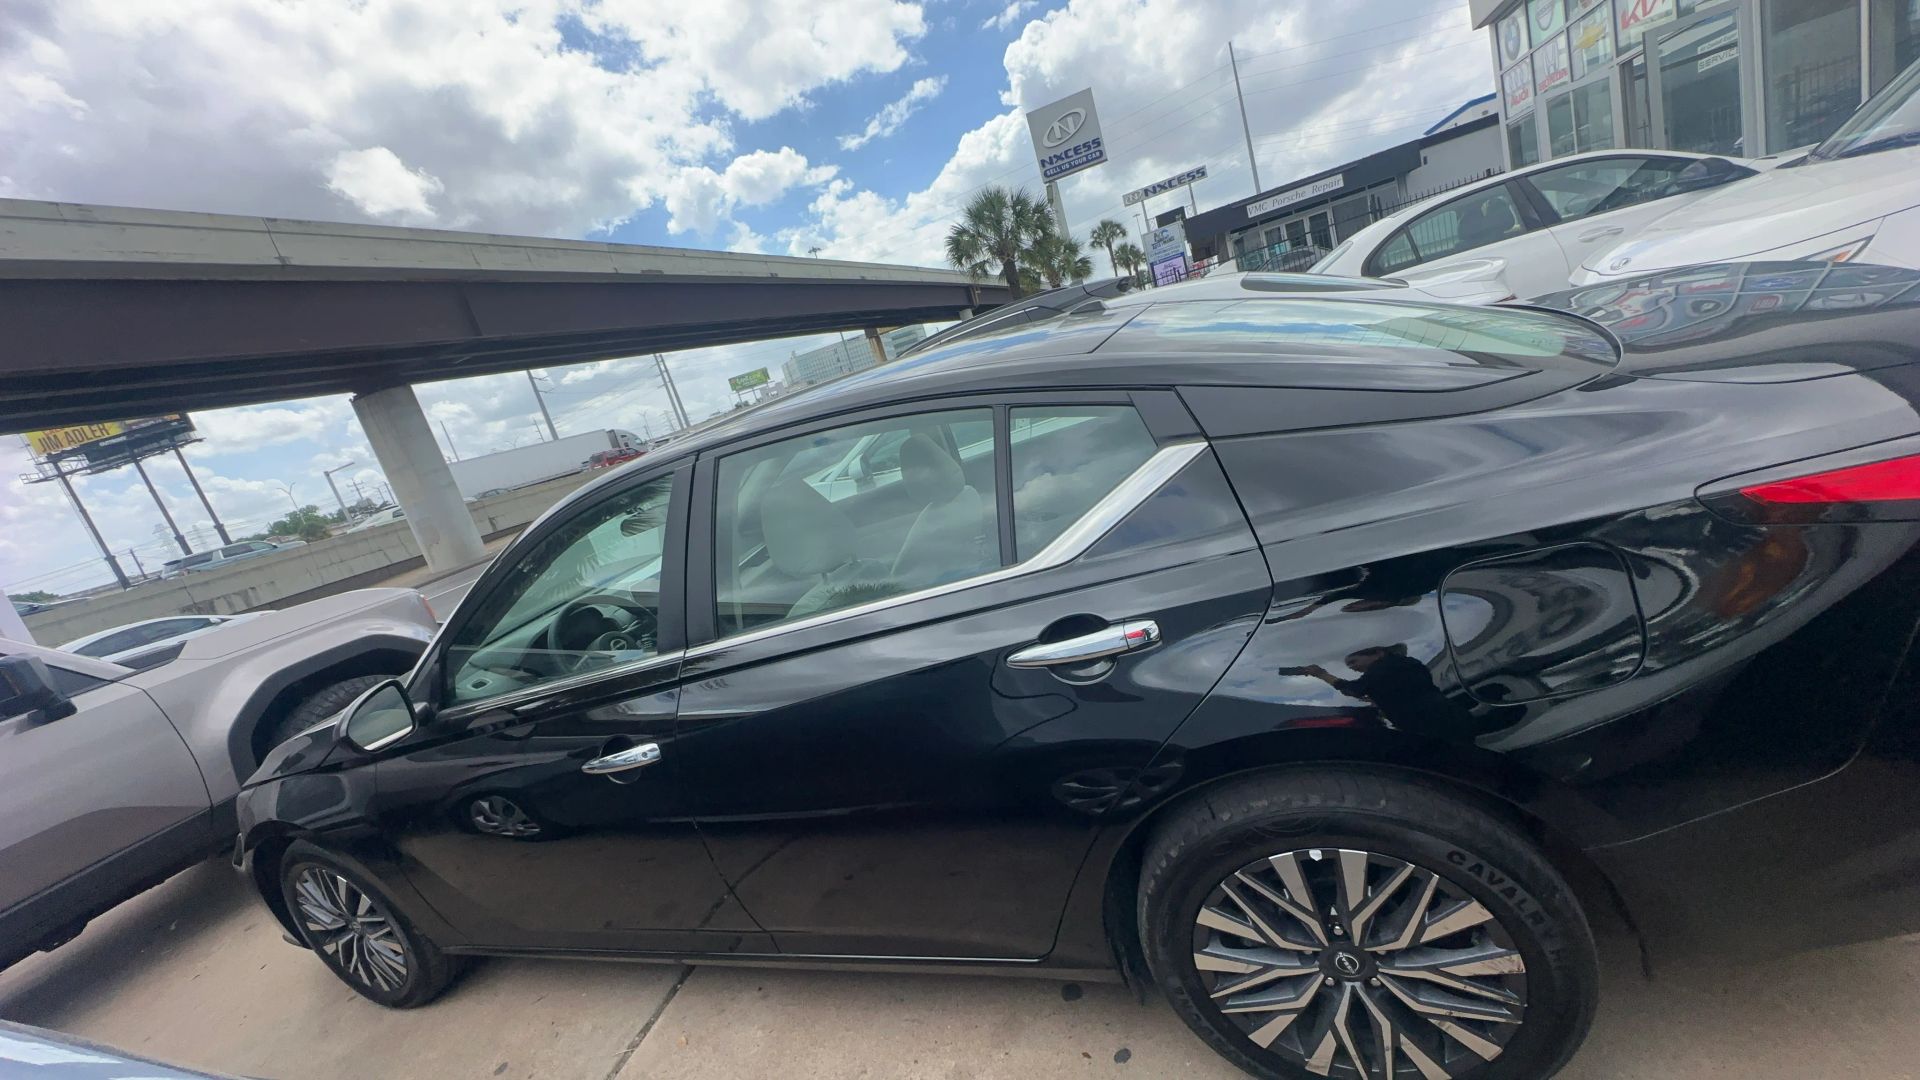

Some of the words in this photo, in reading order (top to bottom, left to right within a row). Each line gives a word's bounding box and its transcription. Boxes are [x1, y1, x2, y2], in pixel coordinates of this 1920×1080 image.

[1699, 48, 1739, 70] SERVIC
[1040, 137, 1102, 168] NXCESS
[1046, 166, 1061, 176] SELL
[1070, 156, 1087, 167] YOUR
[1143, 167, 1206, 197] NXCESS
[1247, 202, 1268, 215] VMC
[1272, 190, 1306, 208] Porsche
[1312, 179, 1341, 195] Repair
[38, 434, 64, 453] JIM
[64, 423, 110, 446] ADLER
